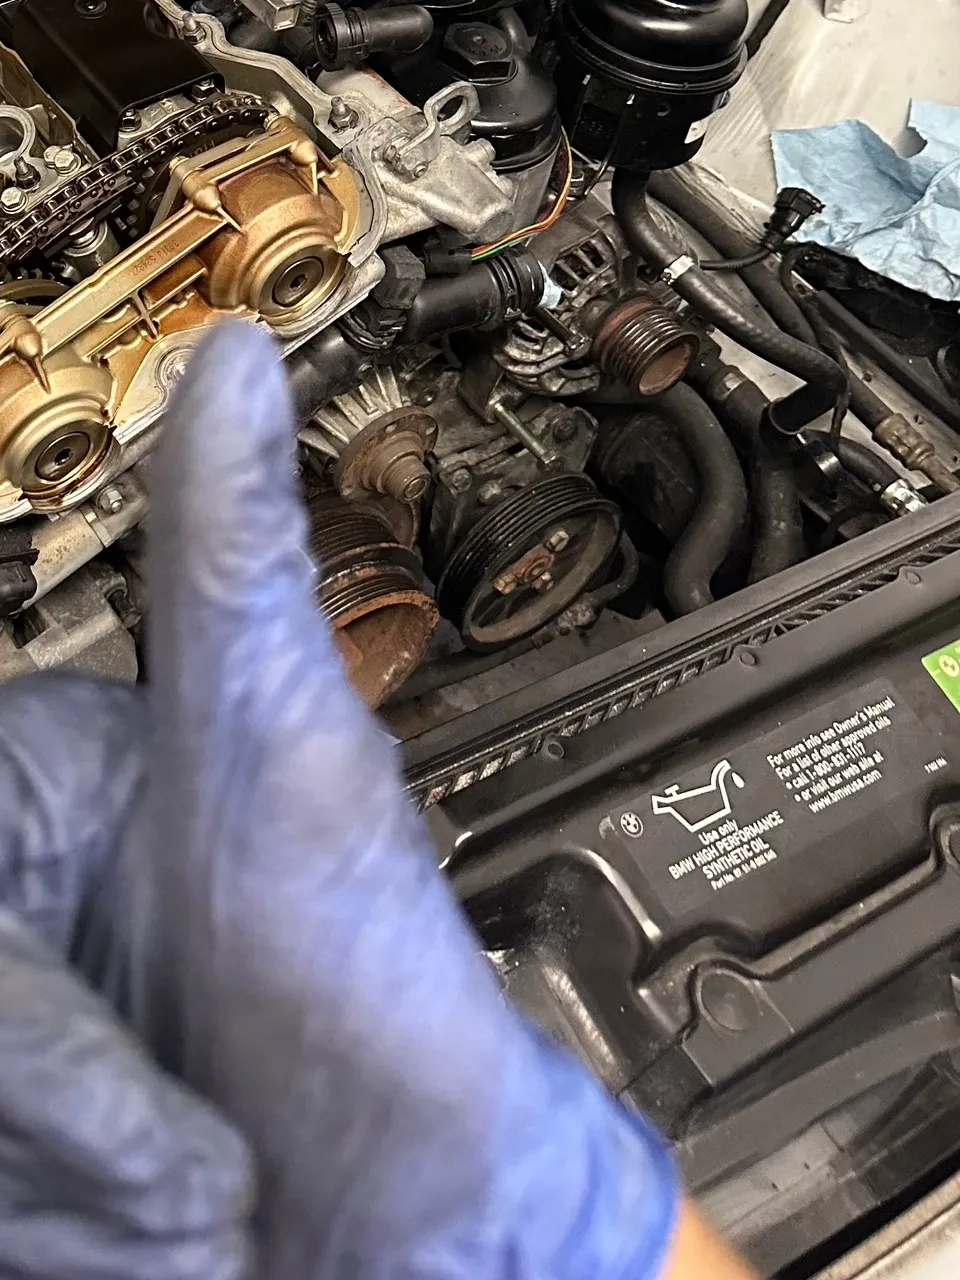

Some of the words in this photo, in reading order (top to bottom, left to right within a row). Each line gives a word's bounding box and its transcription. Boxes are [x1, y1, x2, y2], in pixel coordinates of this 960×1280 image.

[767, 754, 784, 768] For
[783, 743, 806, 760] more
[863, 696, 895, 718] Manual
[775, 765, 792, 780] For
[840, 721, 877, 750] approved
[792, 772, 809, 788] call
[668, 856, 695, 879] BMW
[692, 844, 719, 866] HIGH
[715, 811, 784, 854] PERFORMANCE
[698, 830, 719, 845] Use
[718, 819, 741, 839] only
[702, 844, 753, 879] SYNTHETIC
[750, 837, 769, 853] OIL
